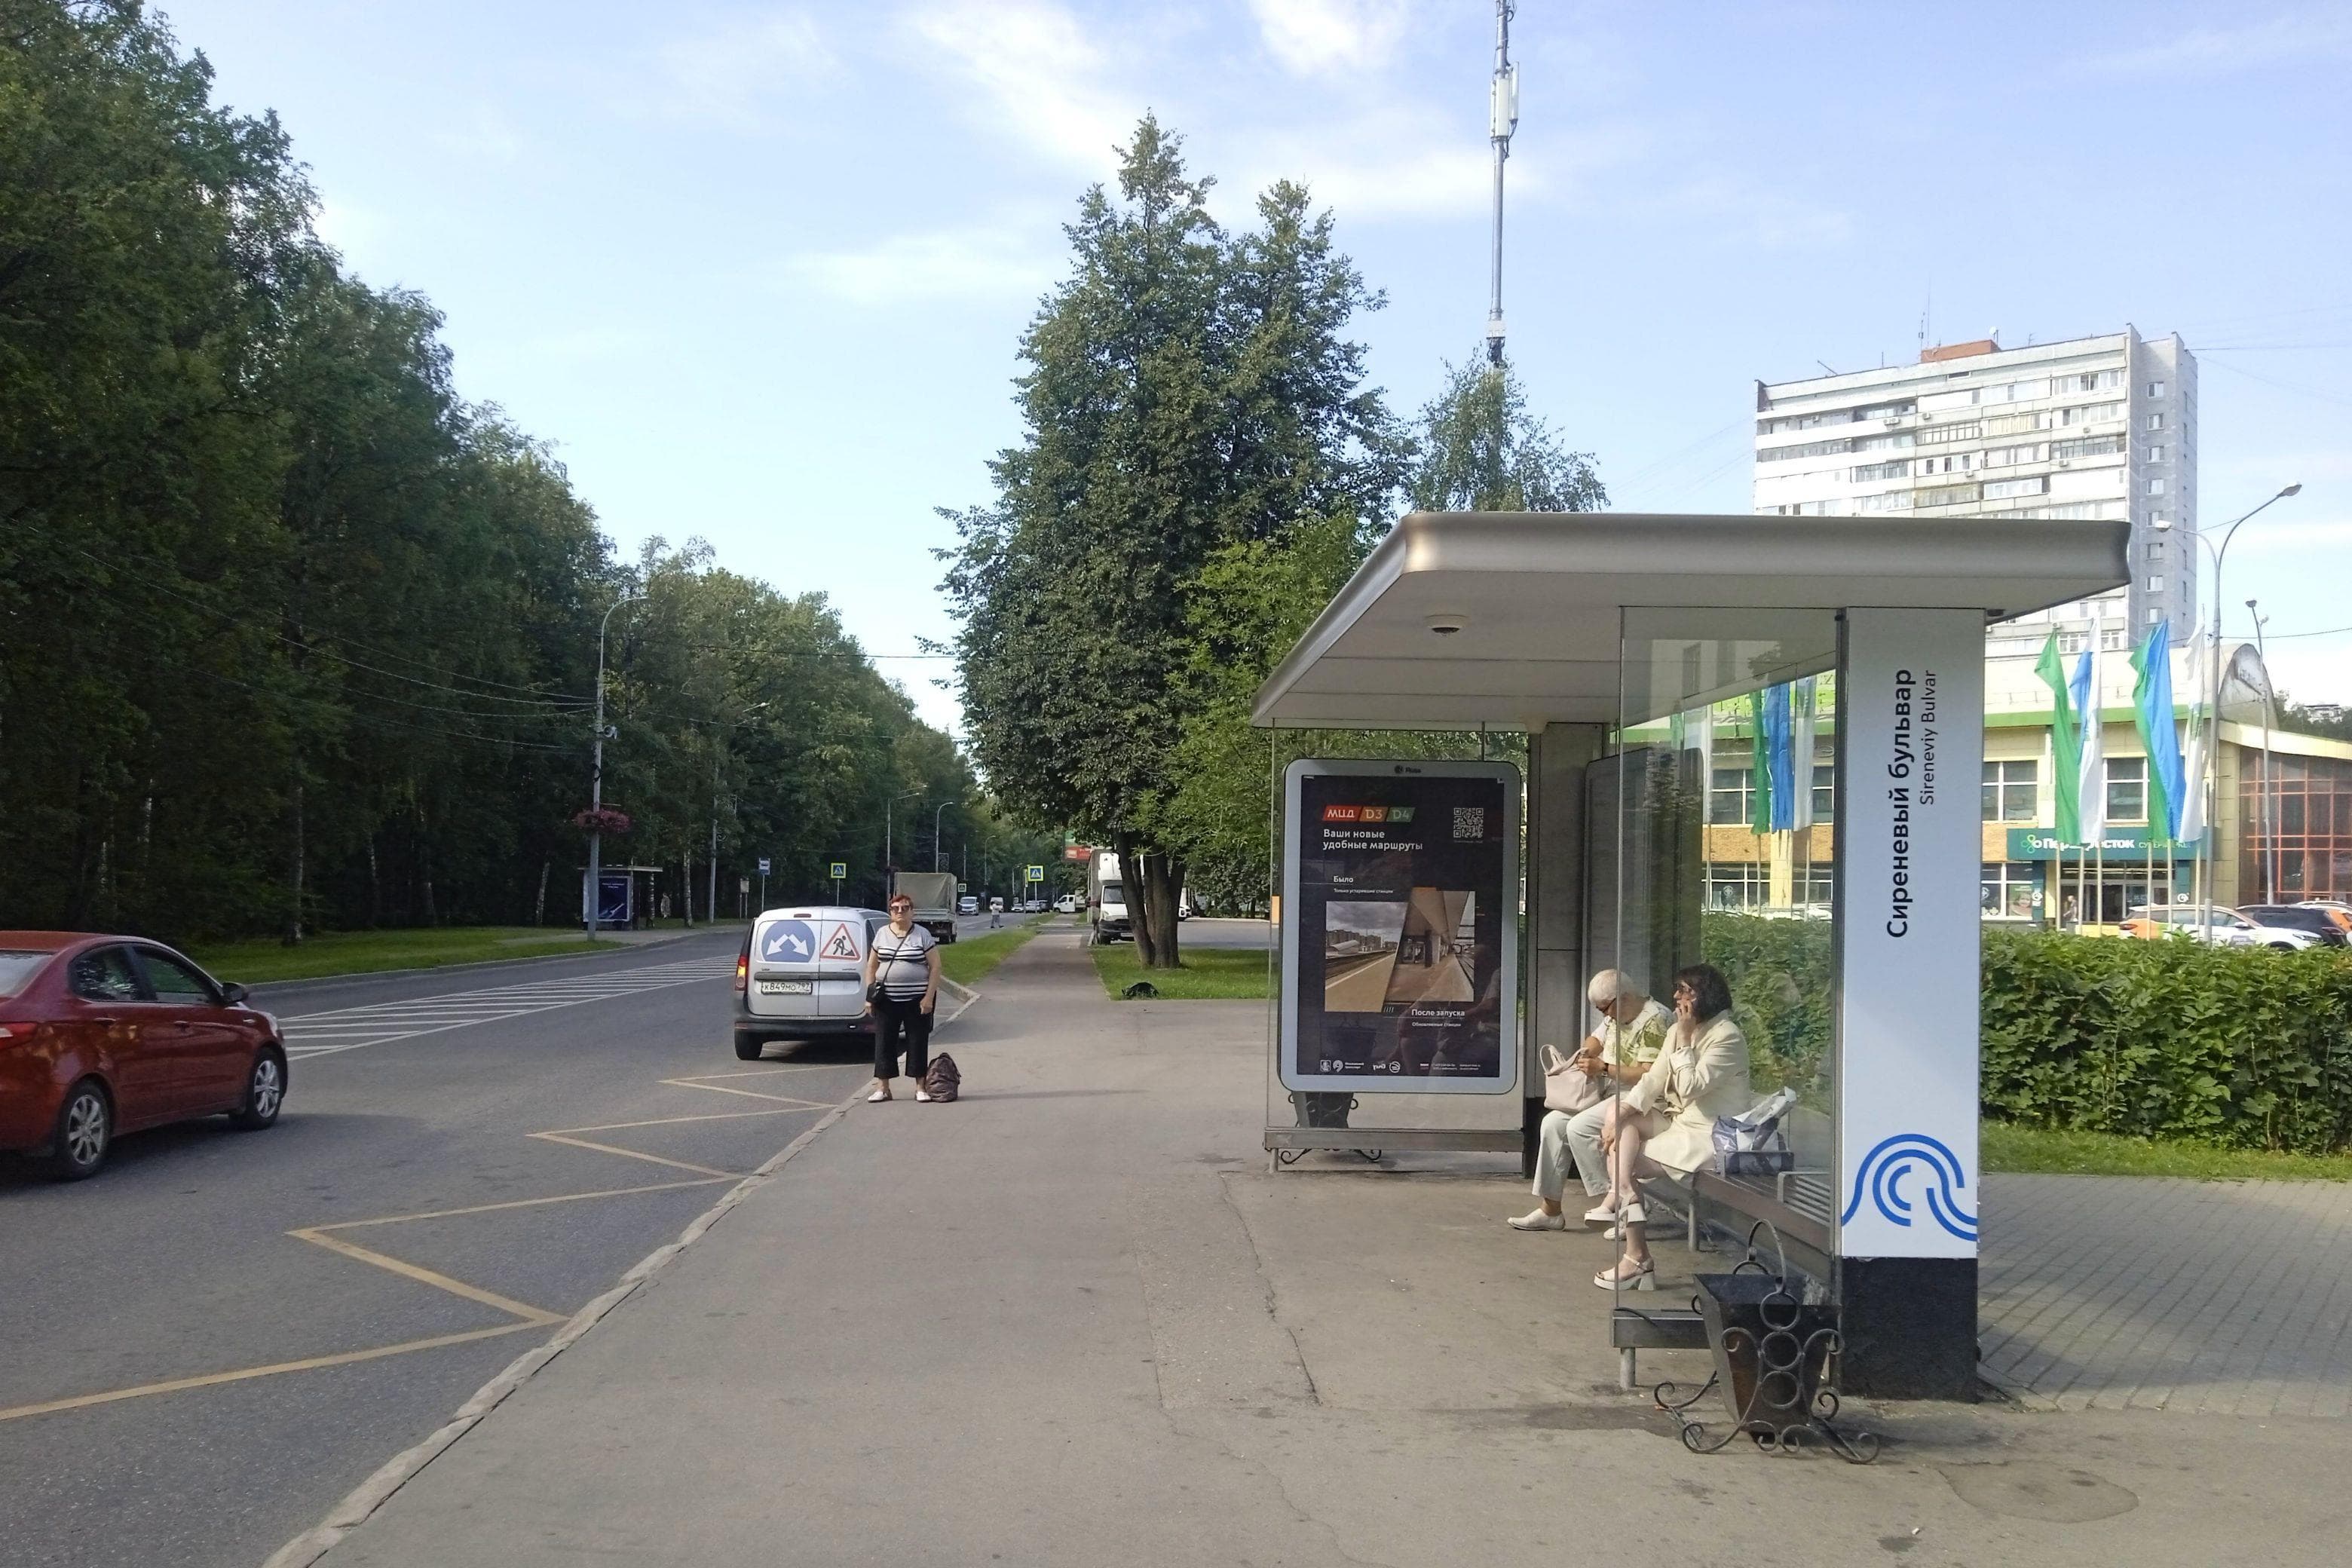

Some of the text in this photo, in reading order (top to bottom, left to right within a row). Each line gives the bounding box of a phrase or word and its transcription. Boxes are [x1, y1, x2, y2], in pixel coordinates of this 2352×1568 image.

[1919, 670, 1939, 805] Sireneviy Bulvar
[1886, 669, 1916, 938] Сиреневый бульвар
[1327, 809, 1410, 819] МЦД D3 D4
[1323, 828, 1350, 838] Ваши
[1322, 840, 1423, 851] удобные маршруты
